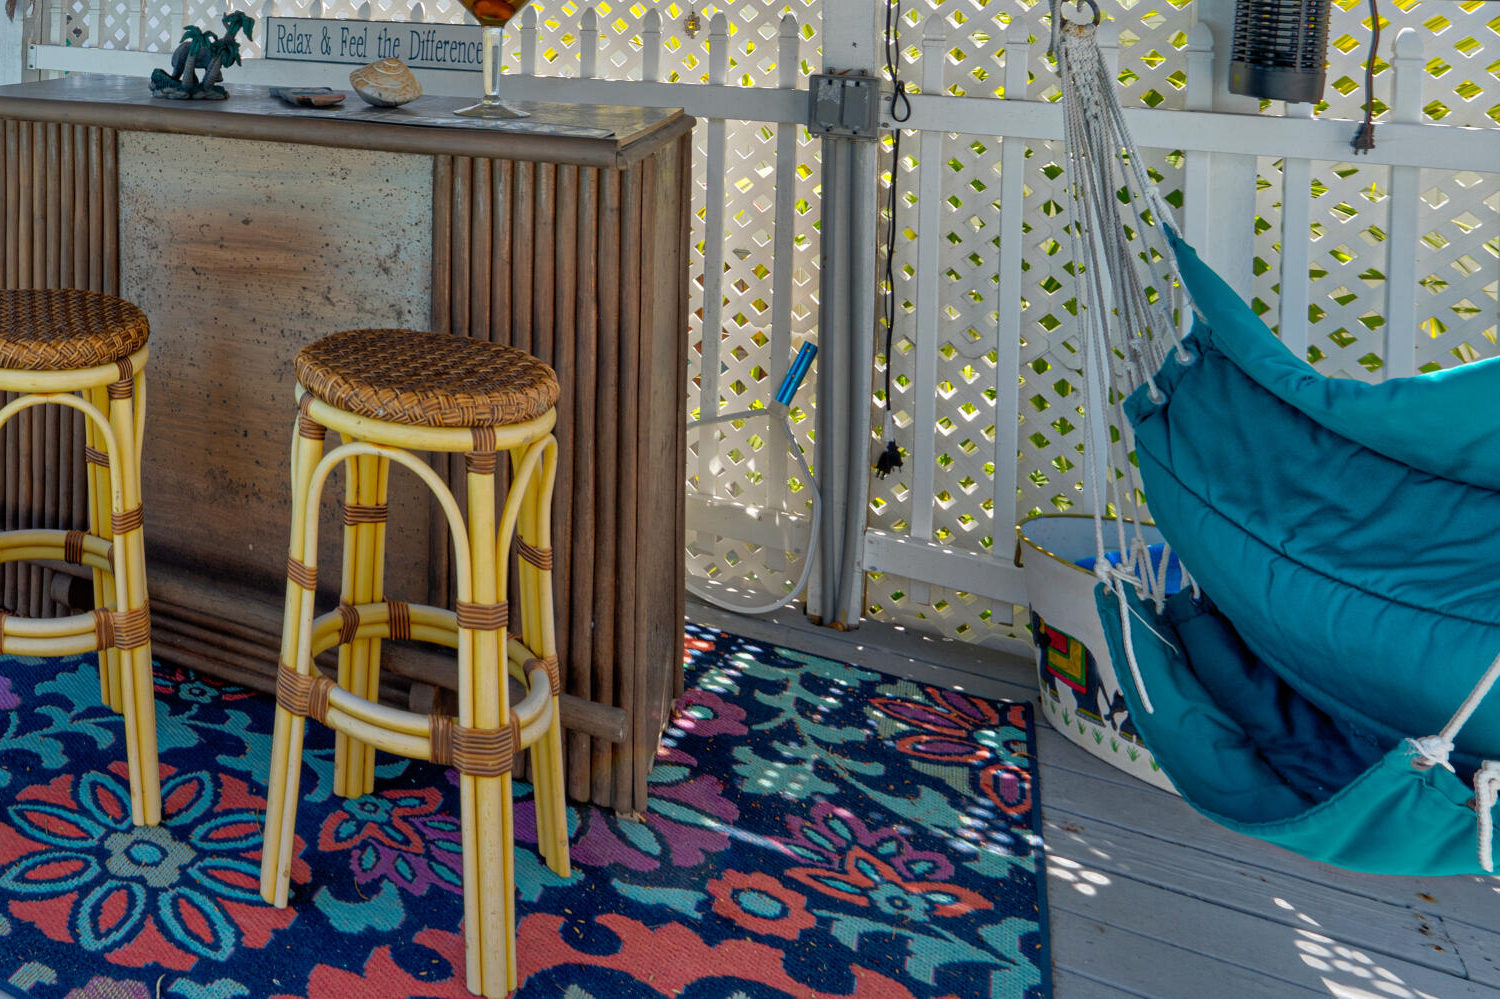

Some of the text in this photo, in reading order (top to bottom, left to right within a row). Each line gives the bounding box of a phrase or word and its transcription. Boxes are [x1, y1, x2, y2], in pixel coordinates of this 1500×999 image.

[276, 23, 484, 65] Relax & Feel the Difference
